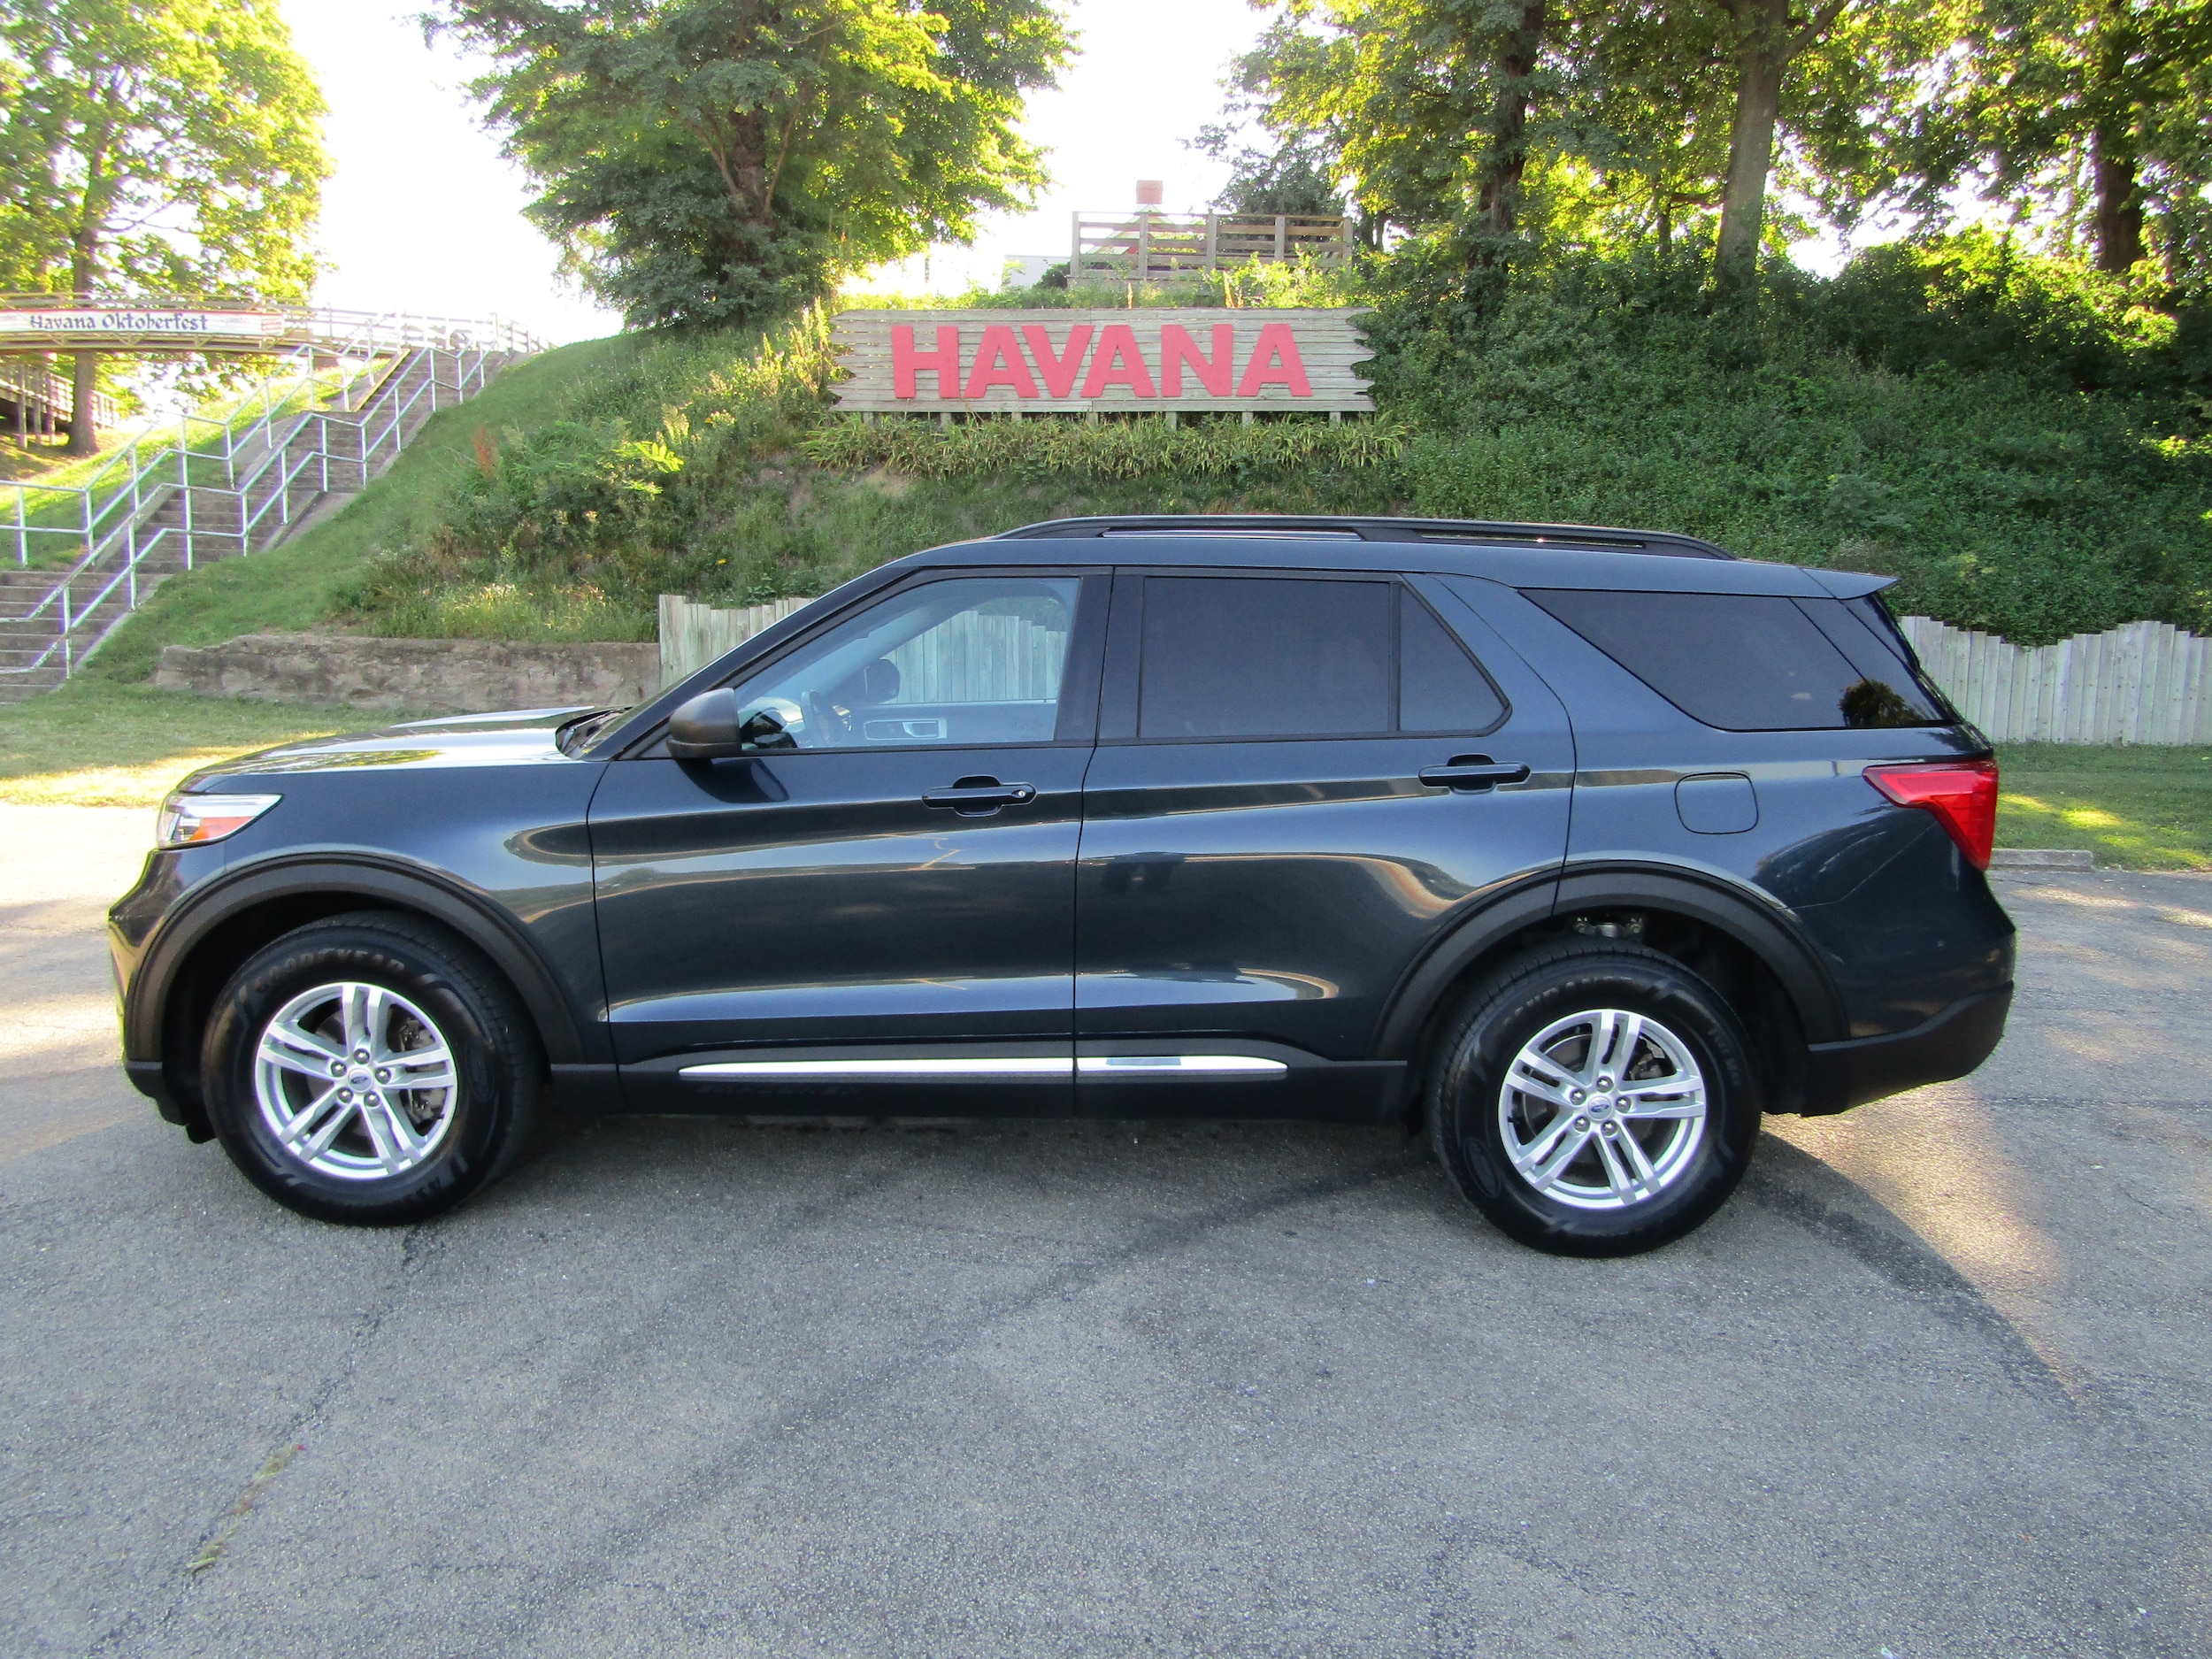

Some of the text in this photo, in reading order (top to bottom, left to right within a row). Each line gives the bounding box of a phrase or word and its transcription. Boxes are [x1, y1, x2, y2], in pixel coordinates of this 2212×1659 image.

[30, 314, 96, 330] Havana
[102, 311, 208, 331] Oktoberfest
[891, 324, 1313, 398] HAVANA
